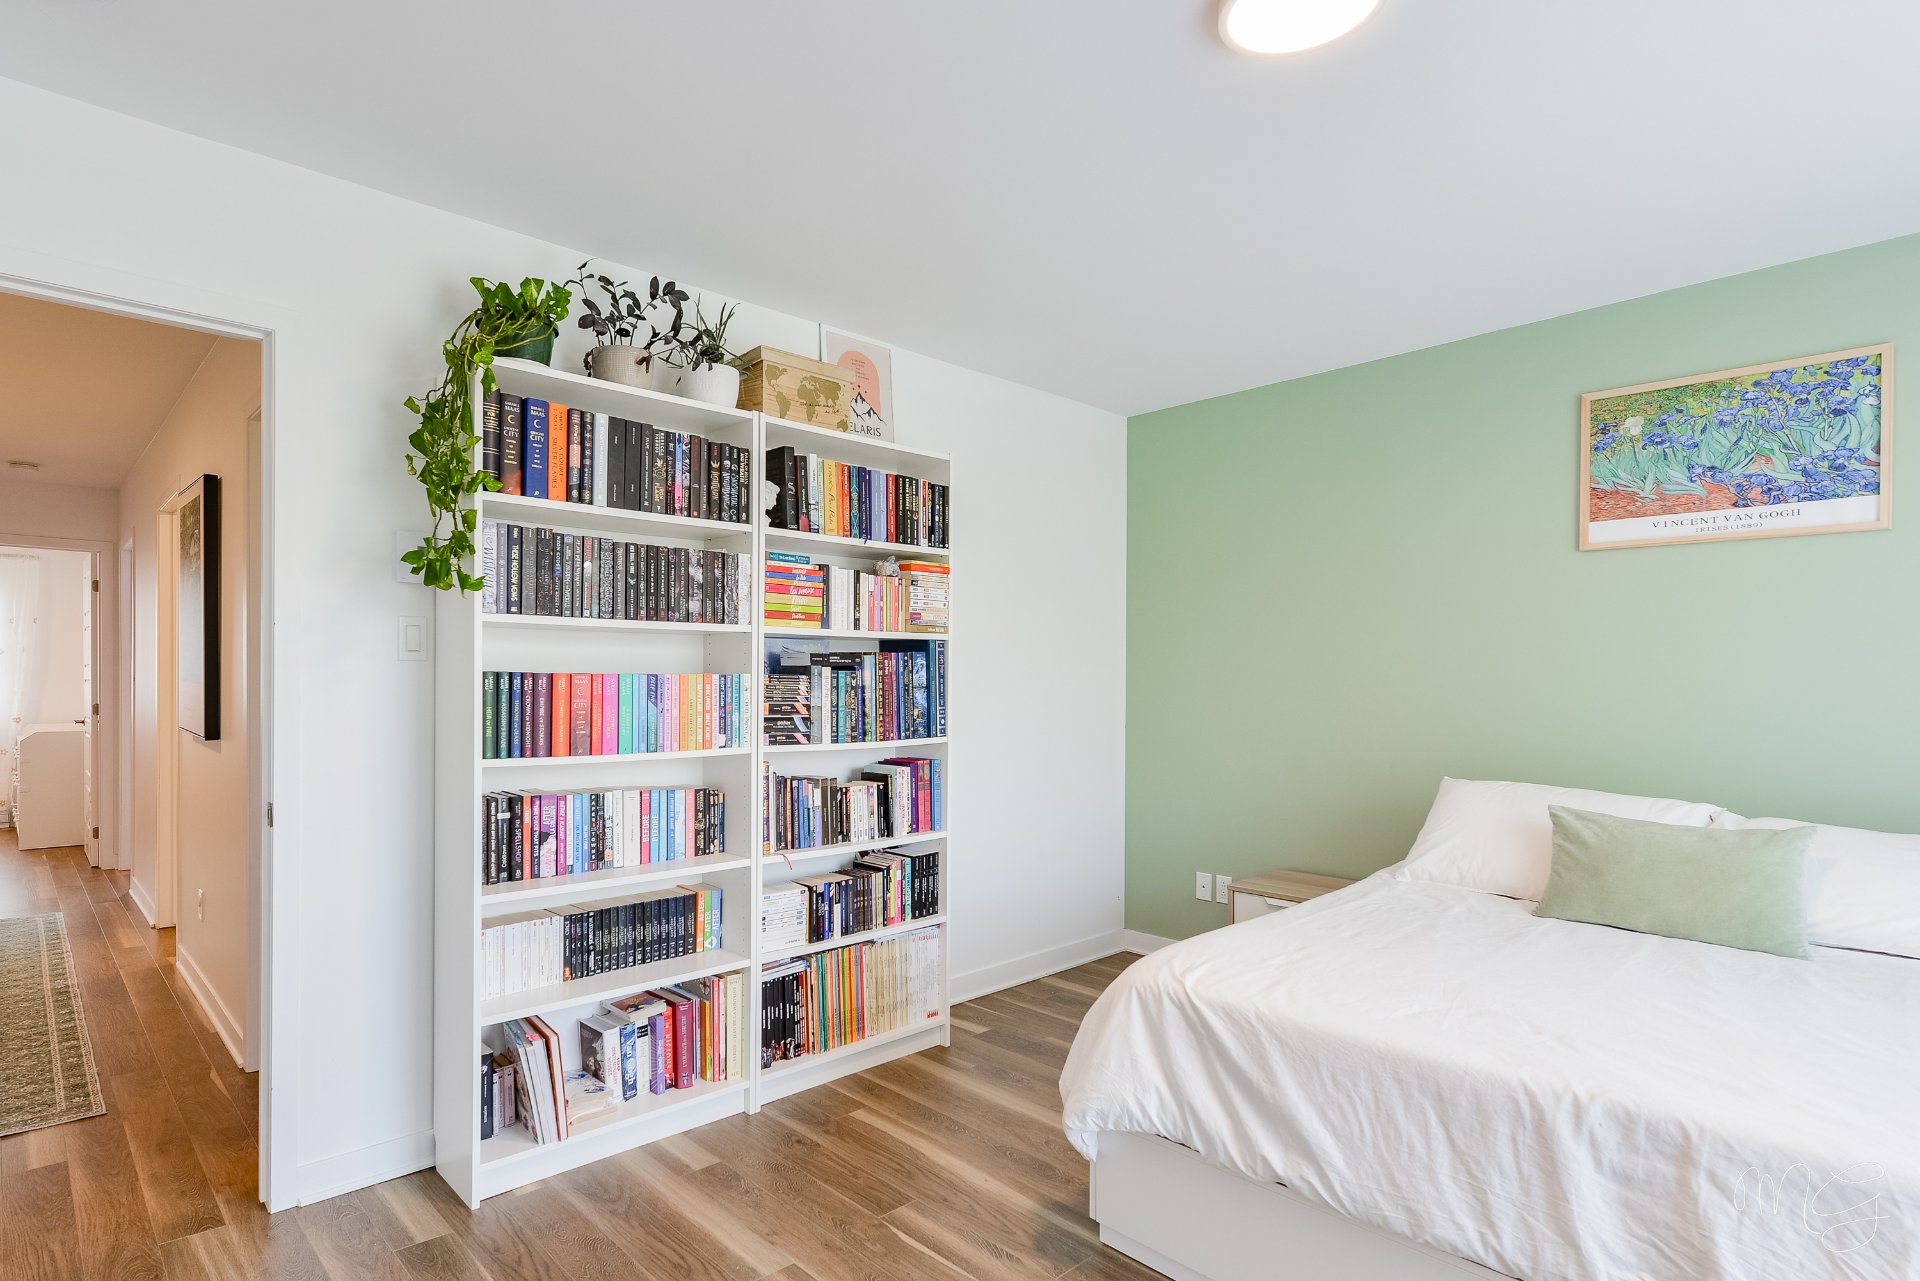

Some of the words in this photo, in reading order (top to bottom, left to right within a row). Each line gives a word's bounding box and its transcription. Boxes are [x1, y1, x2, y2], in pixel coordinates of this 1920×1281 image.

[504, 405, 520, 413] MAAS
[530, 410, 546, 418] MAAS
[503, 429, 520, 438] CITY
[530, 434, 545, 443] CITY
[1651, 515, 1719, 529] VINCENT
[1724, 511, 1754, 523] VAN
[1759, 508, 1801, 520] GOGH
[1695, 524, 1729, 534] IRISES
[1731, 521, 1763, 532] (1889)
[511, 545, 519, 559] THESE
[511, 560, 519, 584] HOLLOW
[511, 585, 519, 602] VOWS
[543, 805, 551, 825] AFTER
[642, 814, 650, 843] BEFORE
[626, 1038, 634, 1057] Van
[625, 1057, 636, 1085] Gogh
